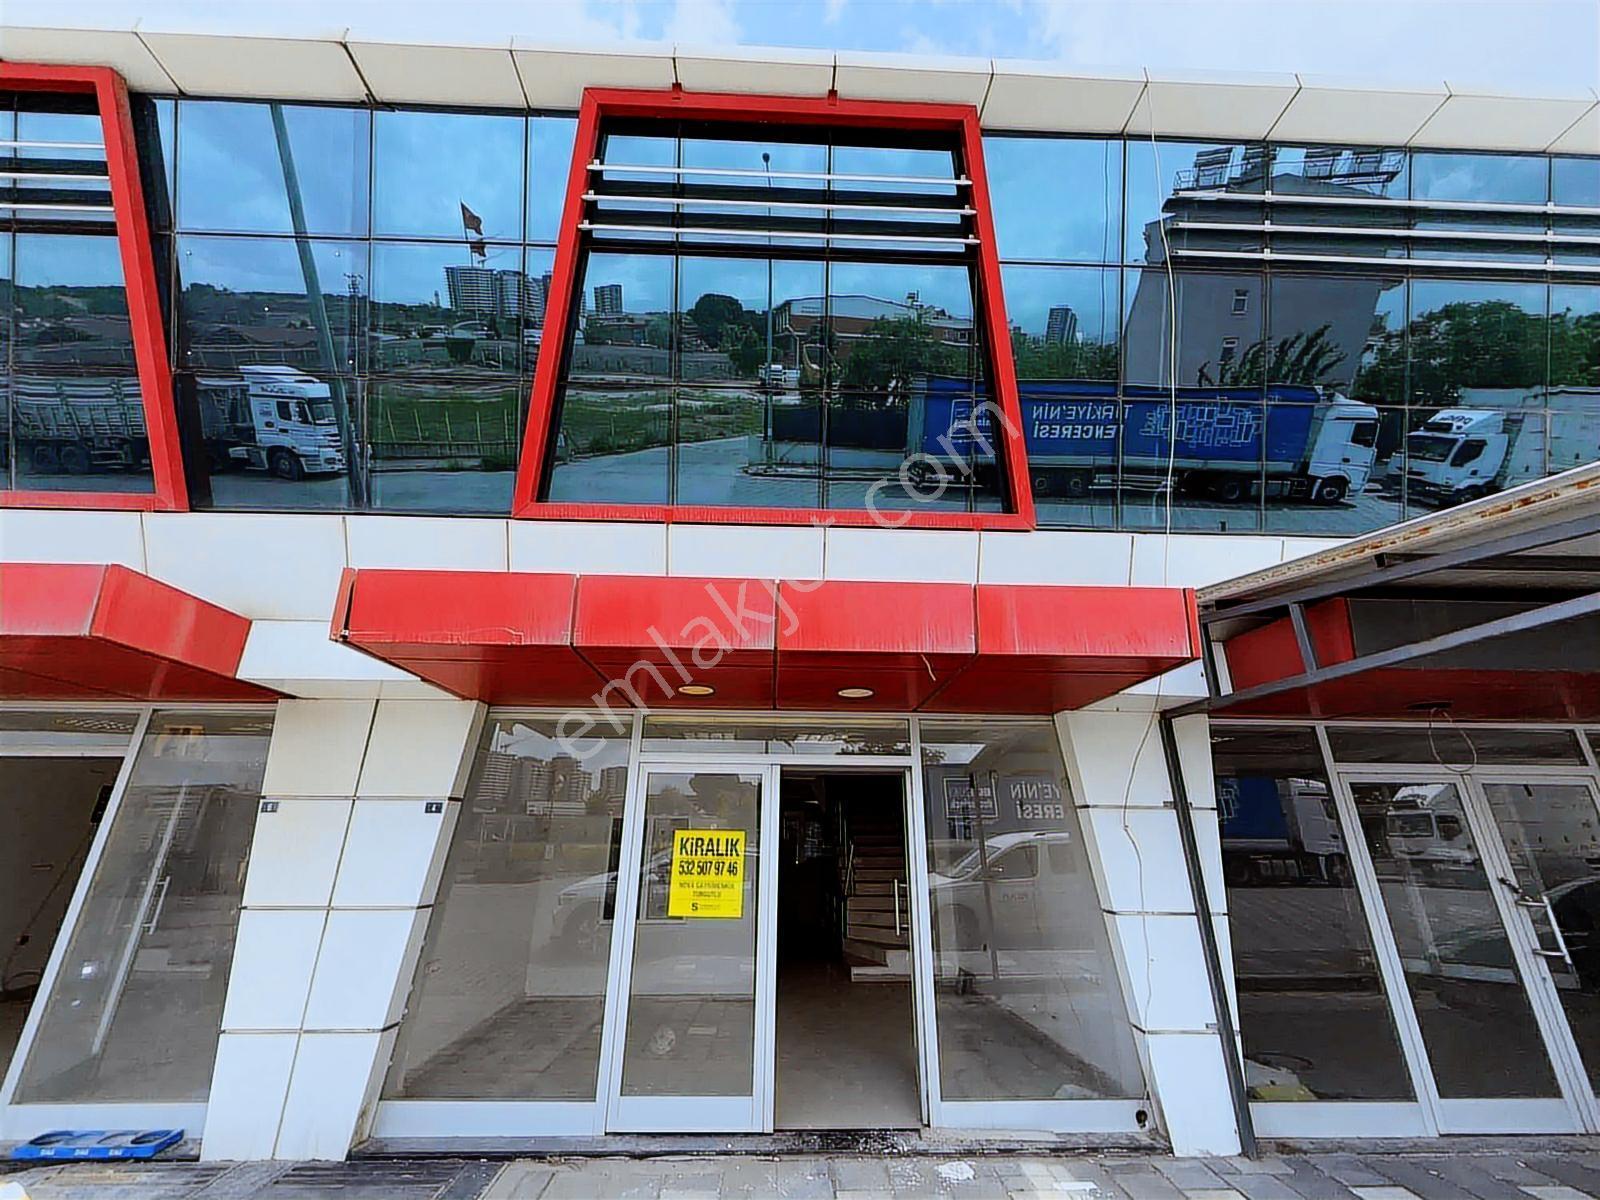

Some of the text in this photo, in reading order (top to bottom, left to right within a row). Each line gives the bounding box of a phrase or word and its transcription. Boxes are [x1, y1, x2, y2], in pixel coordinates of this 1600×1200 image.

[679, 860, 738, 876] 532 507 97 46
